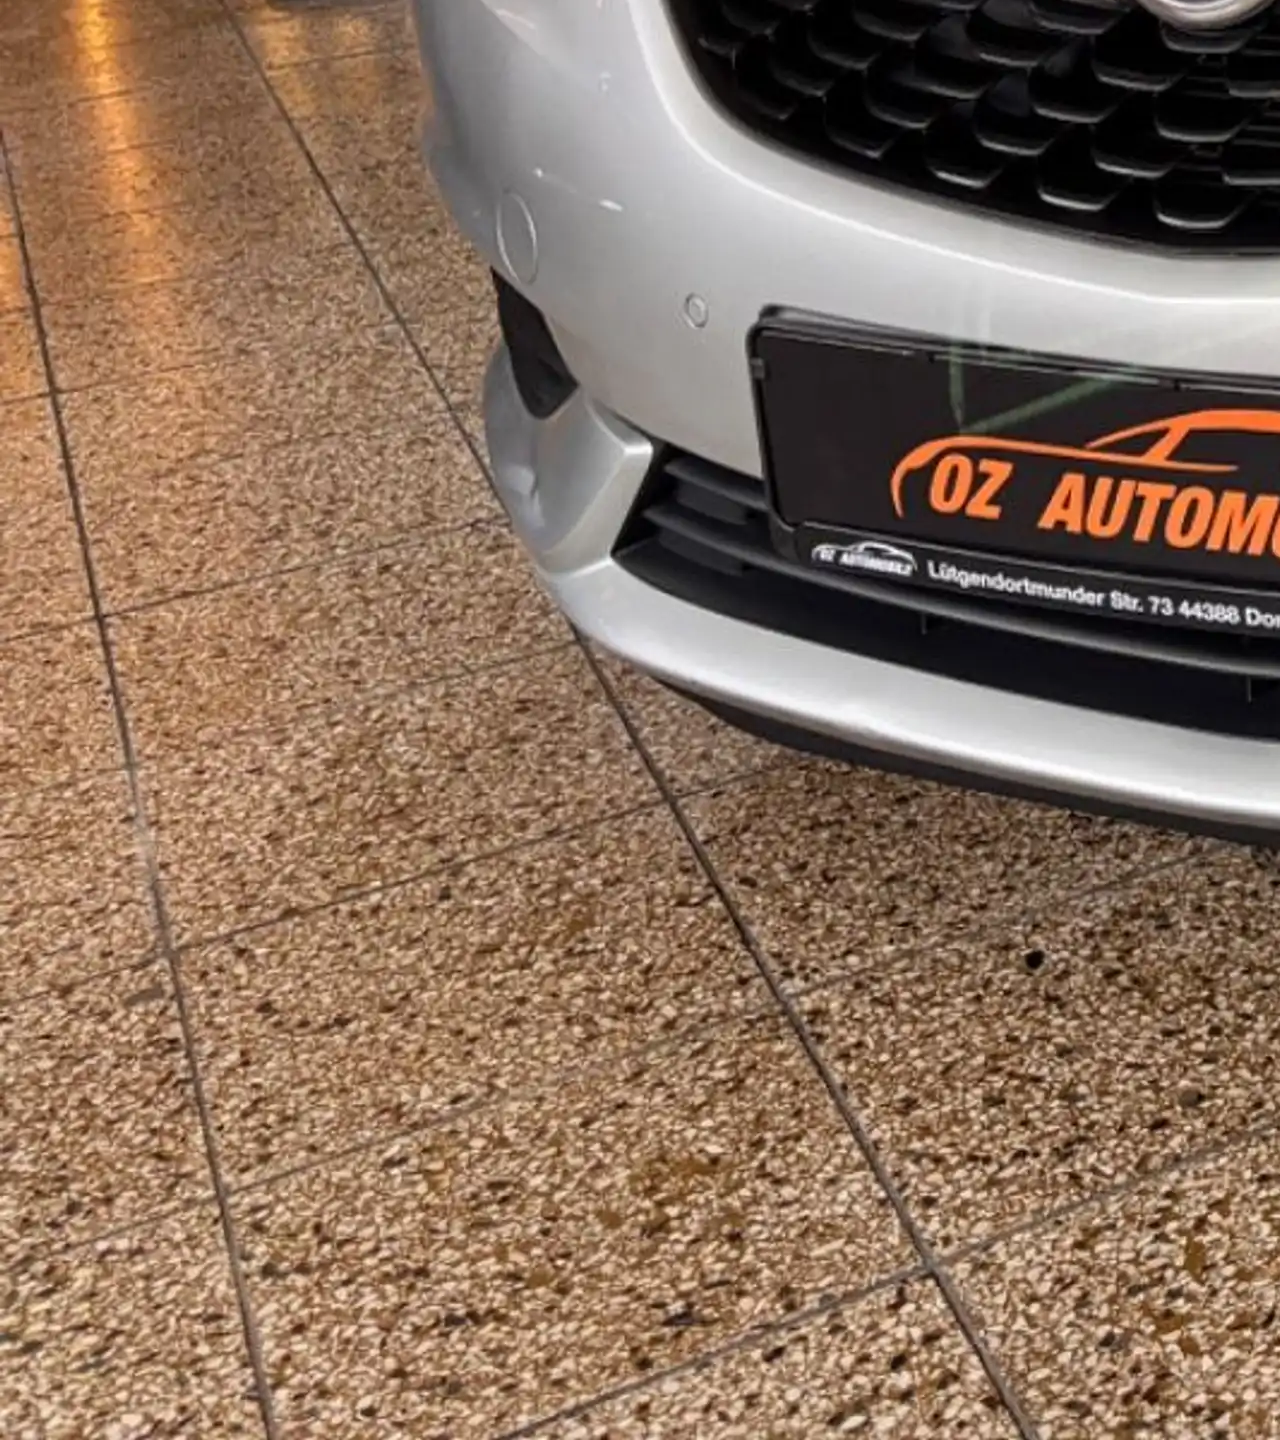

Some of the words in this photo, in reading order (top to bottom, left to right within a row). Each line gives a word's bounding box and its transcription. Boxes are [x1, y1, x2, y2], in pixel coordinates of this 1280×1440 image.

[928, 454, 1013, 519] OZ
[928, 560, 1105, 607] Lütgendortmunder
[1110, 592, 1144, 613] Str.
[1148, 596, 1174, 616] 73
[1179, 600, 1240, 624] 44388
